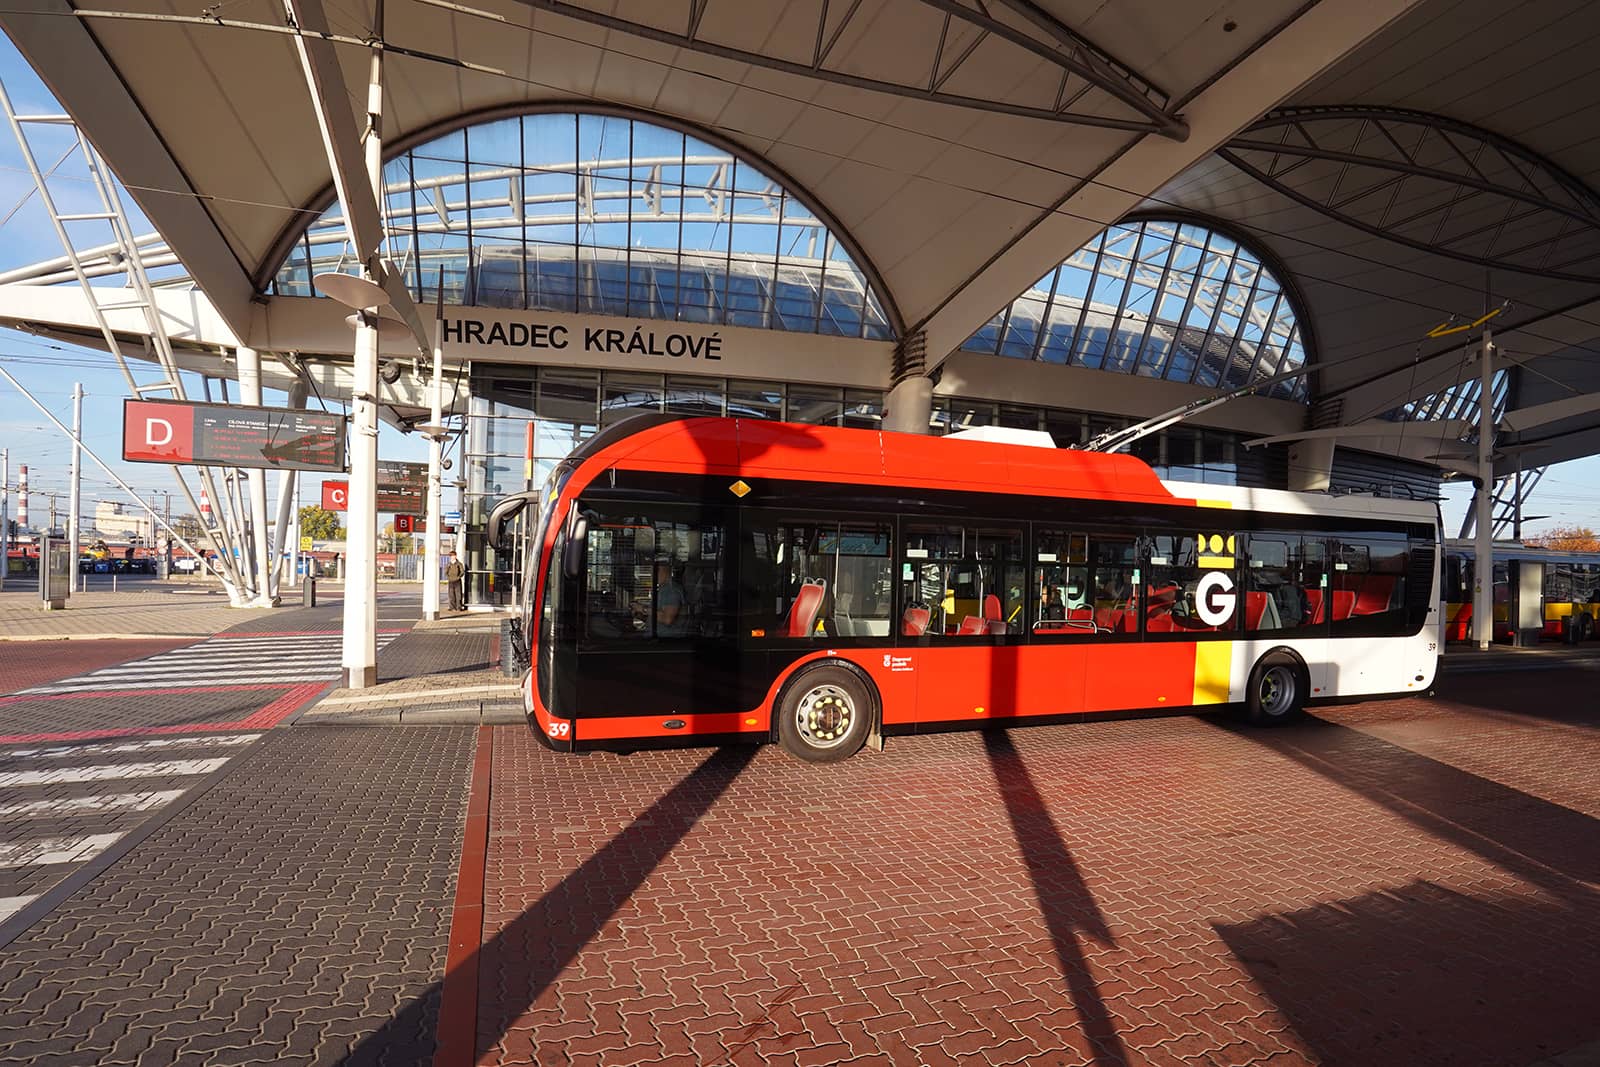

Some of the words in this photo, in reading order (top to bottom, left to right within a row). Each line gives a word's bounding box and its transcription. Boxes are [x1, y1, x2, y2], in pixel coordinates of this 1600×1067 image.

[442, 318, 569, 349] HRADEC
[584, 326, 722, 360] KRÁLOVÉ
[145, 417, 173, 446] D
[331, 489, 345, 503] C
[400, 519, 408, 528] B
[1195, 571, 1236, 626] G
[548, 722, 569, 737] 39
